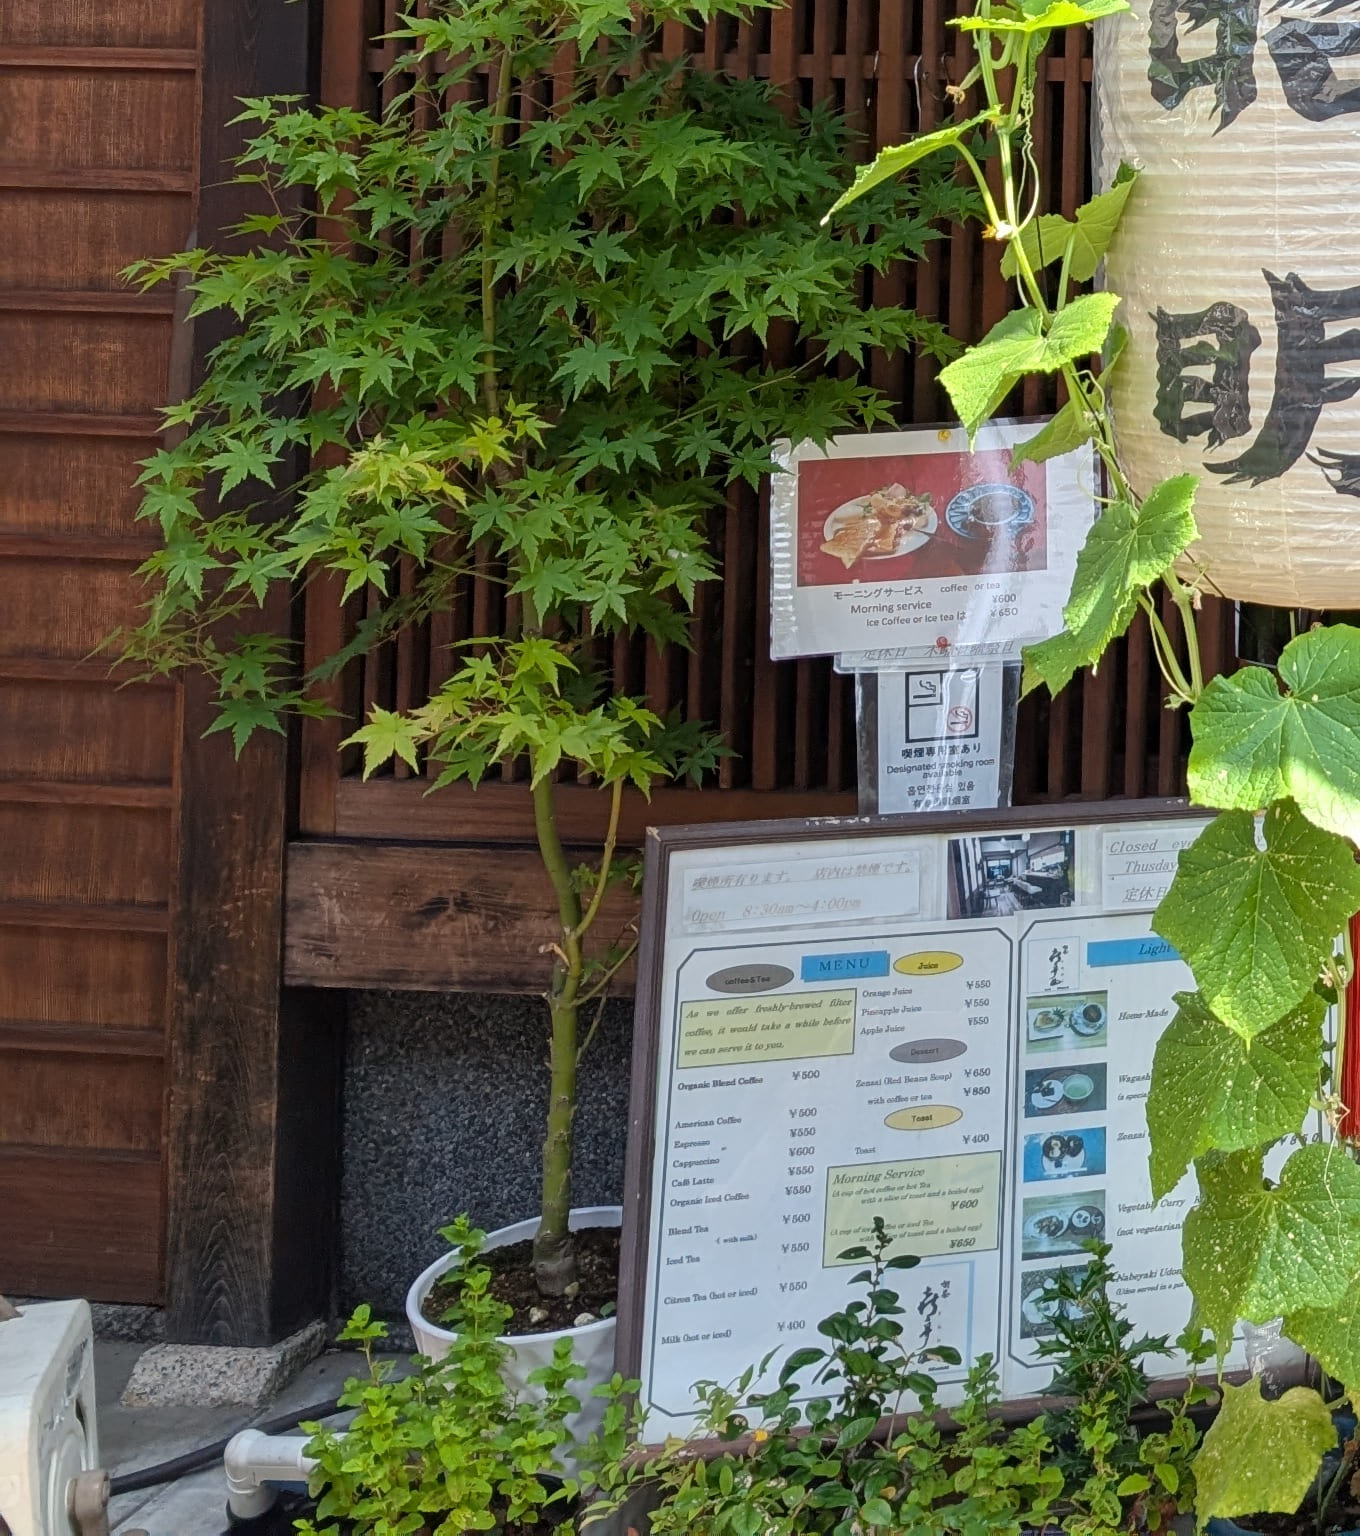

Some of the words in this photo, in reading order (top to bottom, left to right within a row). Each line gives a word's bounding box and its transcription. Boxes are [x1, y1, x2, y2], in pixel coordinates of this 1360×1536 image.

[834, 586, 923, 600] モーニングサービス
[941, 584, 967, 592] coffee
[987, 582, 1000, 590] tea
[851, 603, 894, 614] Morning
[897, 601, 932, 610] service
[992, 594, 1016, 603] ¥600
[882, 617, 910, 625] Coffee
[991, 608, 1018, 617] ¥650
[887, 762, 936, 774] Designated
[1109, 839, 1158, 853] Closed
[691, 908, 725, 922] Open
[1139, 943, 1171, 956] Light
[819, 958, 870, 972] MENU
[918, 962, 938, 970] Juice
[863, 990, 890, 998] Orange
[893, 988, 912, 996] Juice
[966, 980, 991, 989] ¥550
[686, 1010, 699, 1019] As
[726, 1006, 749, 1015] offer
[830, 998, 852, 1008] filter
[861, 1006, 899, 1016] Pineapple
[901, 1005, 922, 1013] Juice
[965, 999, 989, 1008] ¥550
[718, 1027, 725, 1035] it
[730, 1023, 758, 1033] would
[761, 1022, 781, 1031] take
[795, 1019, 820, 1028] while
[823, 1017, 851, 1026] before
[860, 1026, 883, 1035] Apple
[885, 1025, 905, 1033] Juice
[968, 1016, 989, 1025] ¥550
[699, 1047, 715, 1055] can
[718, 1045, 742, 1053] serve
[745, 1043, 752, 1051] it
[755, 1042, 763, 1050] to
[911, 1047, 939, 1056] Dessert
[678, 1082, 710, 1091] Organic
[712, 1079, 736, 1087] Blend
[738, 1076, 763, 1085] Coffee
[792, 1070, 820, 1080] ¥500
[904, 1075, 928, 1084] Beans
[964, 1068, 991, 1077] ¥650
[868, 1097, 885, 1105] with
[675, 1121, 714, 1129] American
[717, 1117, 742, 1125] Coffee
[789, 1108, 817, 1118] ¥500
[912, 1114, 933, 1123] Toast
[674, 1139, 710, 1149] Espresso
[789, 1127, 816, 1137] ¥550
[963, 1134, 989, 1144] ¥400
[673, 1158, 720, 1168] Cappuccino
[789, 1146, 815, 1157] ¥600
[692, 1177, 714, 1185] Latte
[788, 1166, 814, 1176] ¥550
[832, 1172, 882, 1185] Morning
[884, 1168, 925, 1179] Service
[670, 1198, 702, 1207] Organic
[705, 1196, 722, 1204] Iced
[724, 1193, 749, 1202] Coffee
[785, 1185, 811, 1195] ¥550
[950, 1199, 978, 1210] ¥600
[1160, 1199, 1185, 1207] Curry
[668, 1226, 692, 1236] Blend
[783, 1213, 810, 1224] ¥500
[949, 1237, 976, 1248] ¥650
[666, 1257, 683, 1266] Iced
[686, 1255, 700, 1263] Tea
[781, 1242, 809, 1253] ¥550
[664, 1296, 691, 1305] Citron
[692, 1293, 706, 1302] Tea
[709, 1292, 725, 1300] (hot
[779, 1281, 807, 1292] ¥550
[662, 1336, 681, 1344] Milk
[683, 1333, 699, 1342] (hot
[777, 1320, 805, 1331] ¥400
